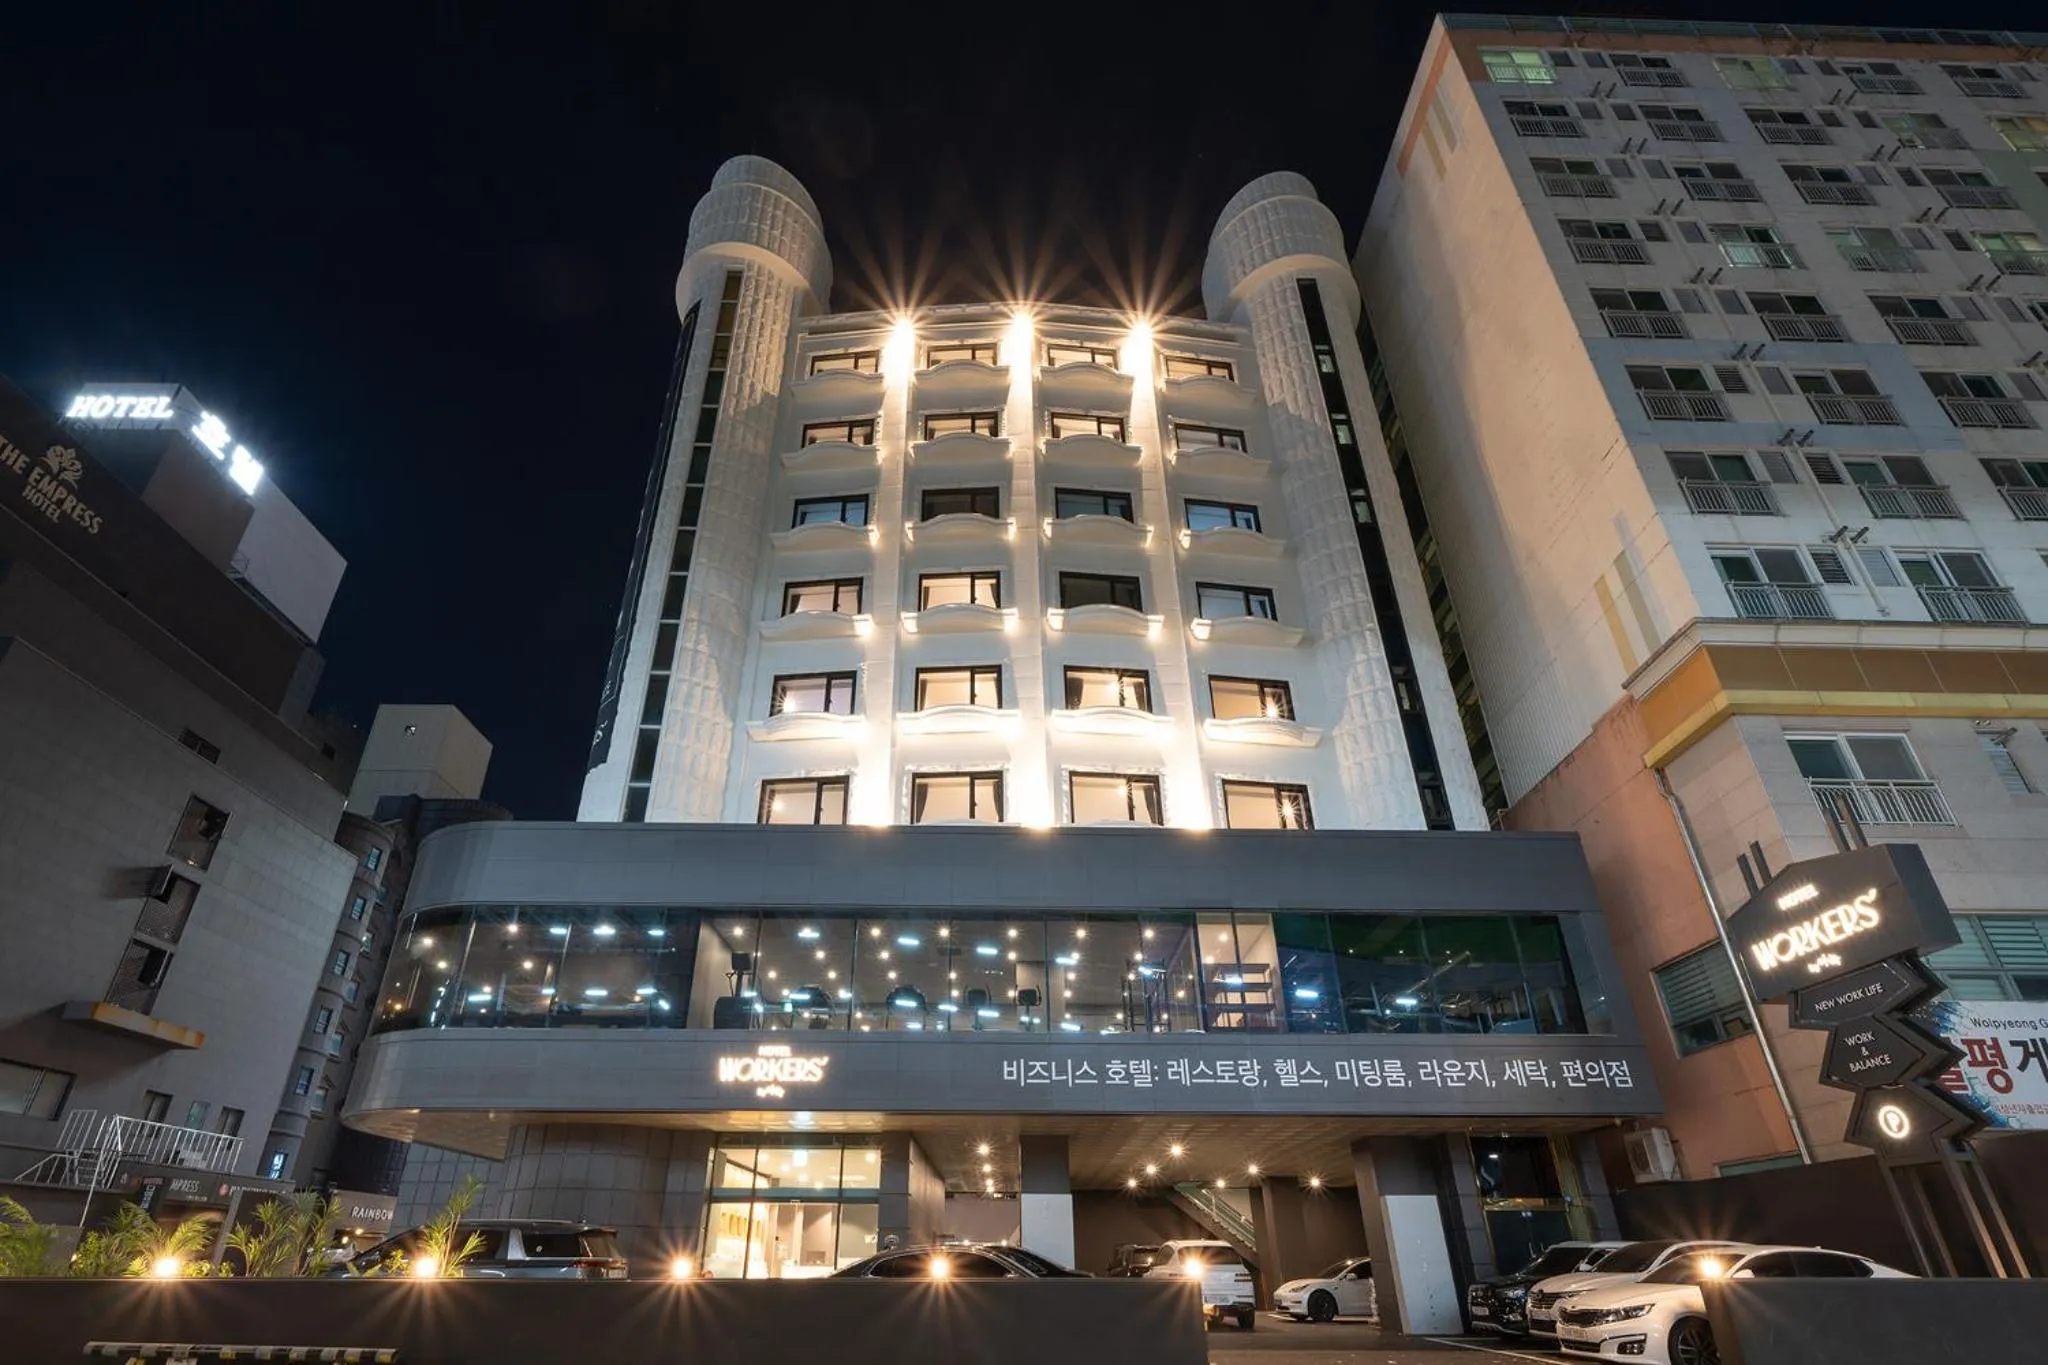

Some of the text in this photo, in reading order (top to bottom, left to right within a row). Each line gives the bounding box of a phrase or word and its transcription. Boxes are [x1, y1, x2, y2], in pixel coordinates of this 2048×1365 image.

[66, 396, 174, 418] HOTEL
[22, 485, 60, 523] HOTEL
[28, 466, 102, 534] EMPRESS
[1814, 982, 1884, 1013] NEW WORK LIFE
[1971, 1018, 2038, 1031] Wolpyeong
[1844, 1031, 1876, 1047] WORK
[1861, 1046, 1869, 1056] &
[1003, 1058, 1634, 1088] 비즈니스 호텔: 레스토랑, 헬스, 미팅룸, 라운지, 세탁, 편의점
[1849, 1054, 1893, 1073] BALANCE
